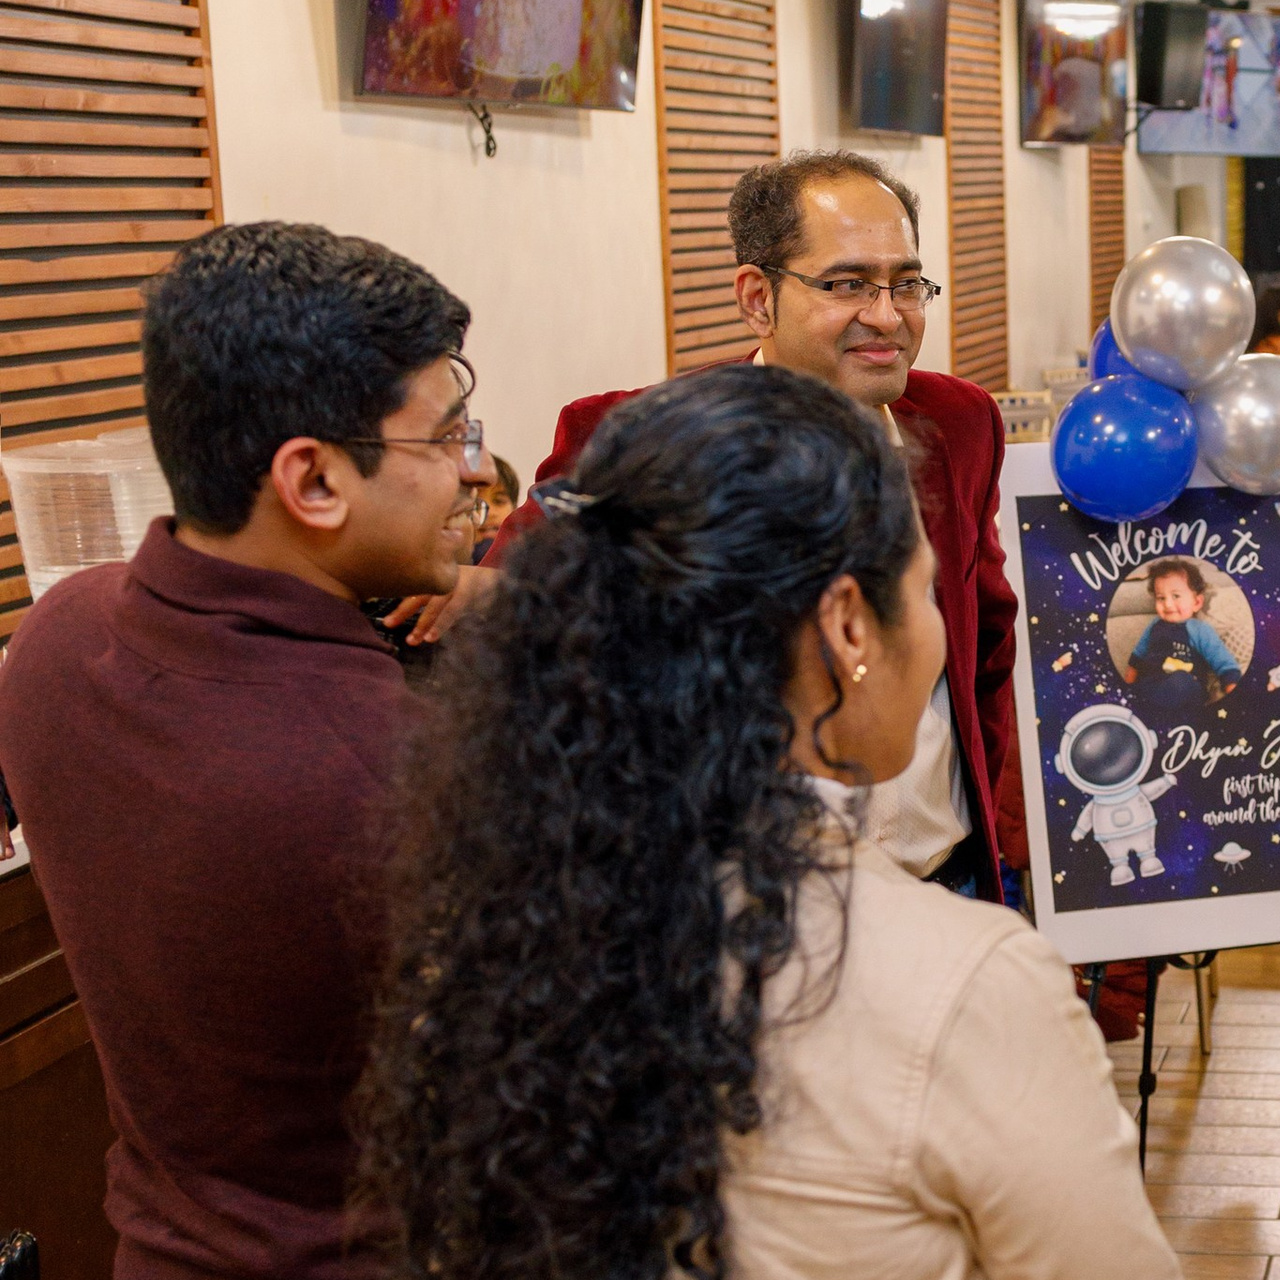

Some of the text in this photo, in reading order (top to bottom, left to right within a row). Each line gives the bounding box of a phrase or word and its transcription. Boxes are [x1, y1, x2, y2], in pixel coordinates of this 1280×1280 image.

[1070, 519, 1263, 590] Welcome to
[1161, 725, 1253, 779] Dhyan
[1223, 773, 1256, 805] first
[1203, 798, 1257, 826] around
